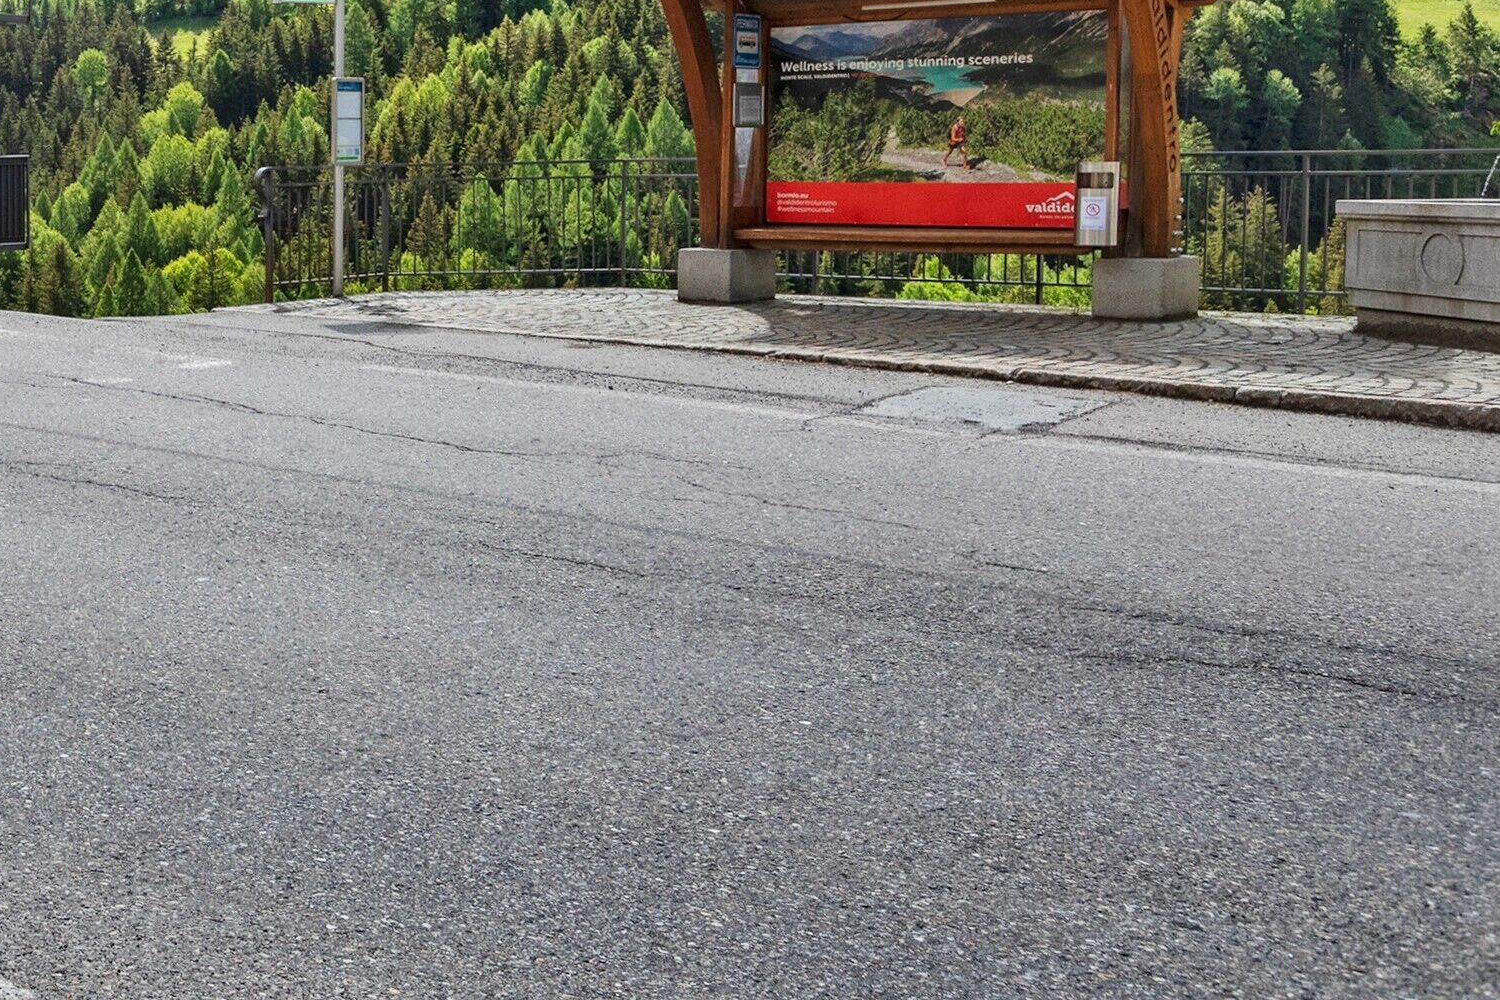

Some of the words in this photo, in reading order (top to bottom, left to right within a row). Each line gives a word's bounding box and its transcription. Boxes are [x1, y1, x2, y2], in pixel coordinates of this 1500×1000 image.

[780, 61, 835, 73] Wellness
[837, 59, 847, 71] is
[849, 57, 905, 71] enjoying
[907, 55, 965, 68] stunning
[968, 52, 1034, 65] sceneries
